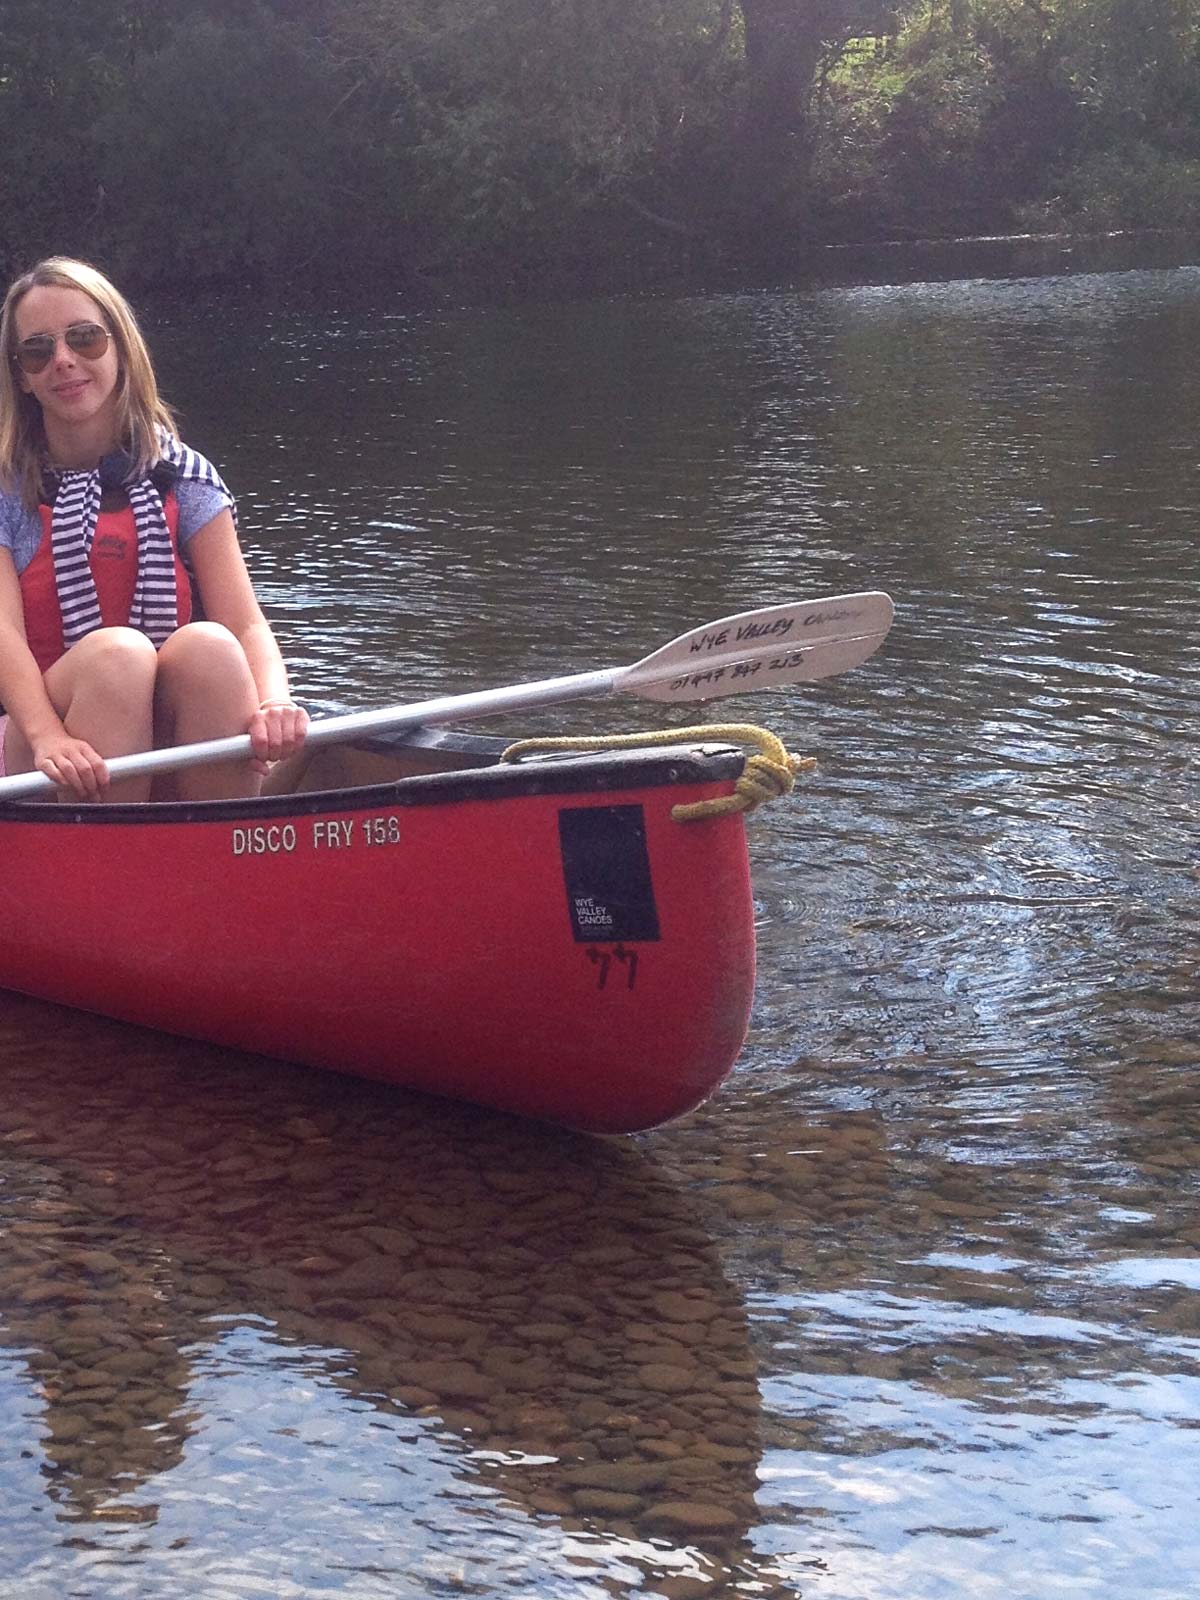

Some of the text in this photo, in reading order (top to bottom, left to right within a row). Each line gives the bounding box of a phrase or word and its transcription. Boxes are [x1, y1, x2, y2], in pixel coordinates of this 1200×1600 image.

[690, 629, 731, 653] WYE
[736, 618, 795, 641] VALLEY
[232, 815, 401, 855] DISCO FRY 158
[575, 898, 594, 907] WYE
[576, 906, 607, 916] VALLEY
[578, 915, 613, 925] CANOES
